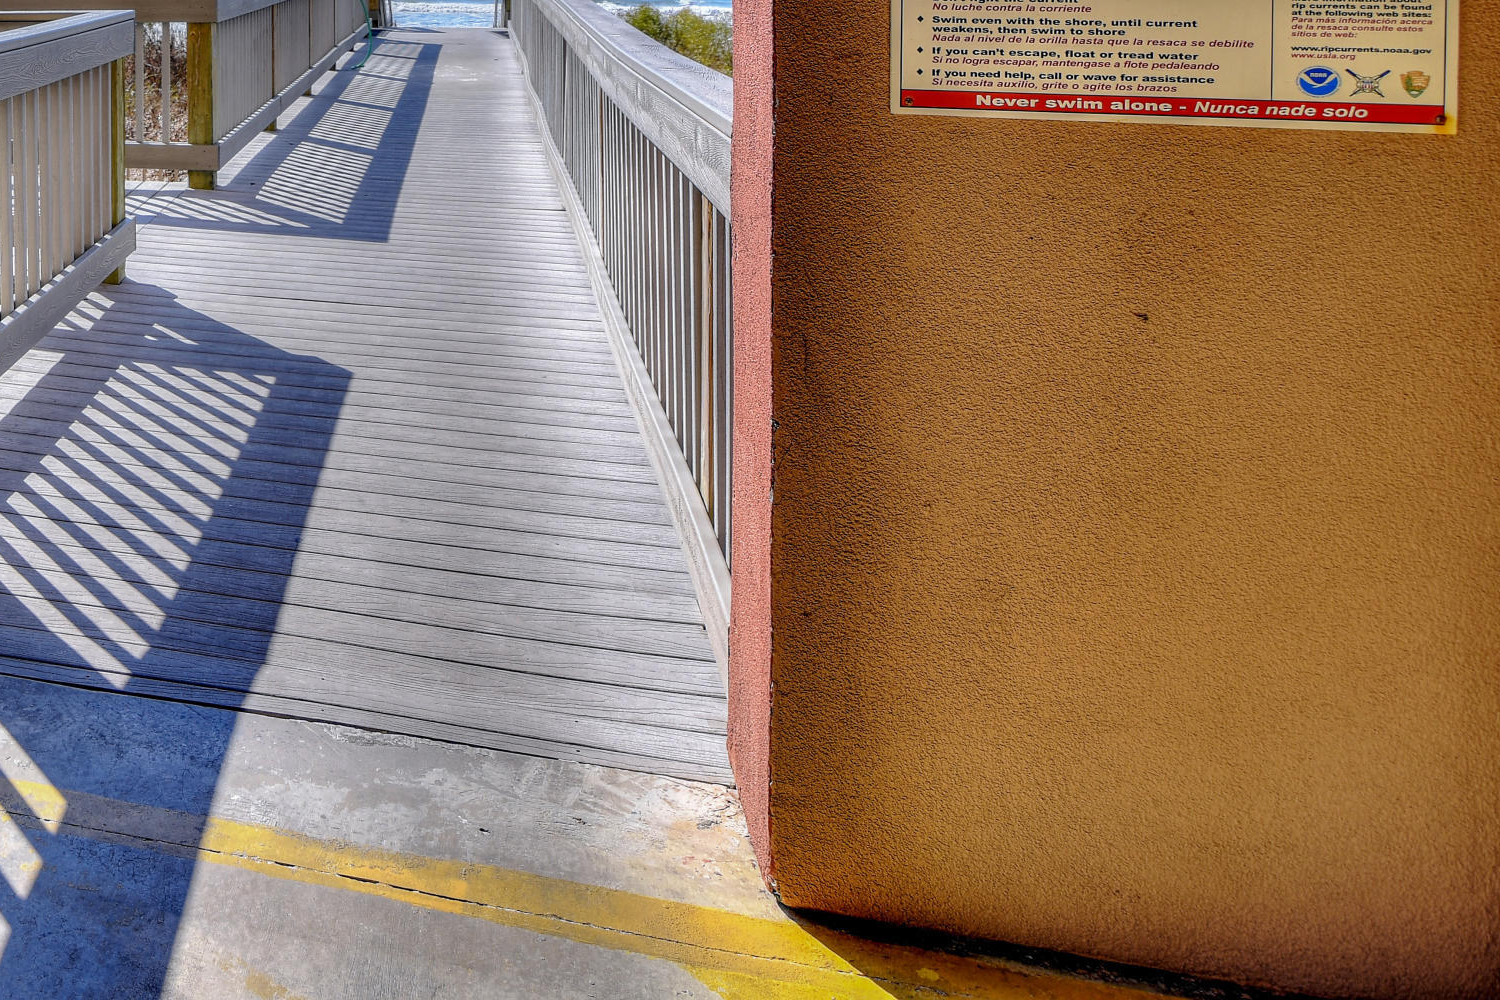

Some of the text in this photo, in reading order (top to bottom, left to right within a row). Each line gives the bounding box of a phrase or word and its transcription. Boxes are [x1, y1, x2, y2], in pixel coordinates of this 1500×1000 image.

[932, 3, 948, 11] No
[1039, 5, 1092, 13] corriente
[1325, 10, 1373, 18] following
[932, 16, 967, 24] Swim
[1006, 17, 1035, 25] with
[1065, 19, 1107, 27] shore,
[1146, 20, 1198, 28] current
[932, 26, 993, 34] weakens,
[1031, 27, 1065, 35] swim
[1088, 28, 1126, 36] shore
[1072, 37, 1104, 45] hasta
[1209, 40, 1254, 48] debilite
[972, 48, 1004, 56] can't
[1009, 50, 1060, 58] escape,
[1291, 46, 1432, 54] www.ripcurrents.noaa.gov
[963, 57, 990, 66] logra
[993, 59, 1038, 67] escapar,
[1124, 61, 1149, 69] flote
[1151, 62, 1220, 70] pedaleando
[1005, 71, 1035, 80] help,
[1039, 72, 1062, 80] call
[1121, 74, 1138, 82] for
[1142, 75, 1215, 84] assistance
[947, 79, 993, 87] necesita
[997, 80, 1038, 89] auxilio,
[1042, 82, 1069, 90] grite
[1083, 83, 1111, 92] agite
[1137, 84, 1177, 93] brazos
[976, 94, 1039, 108] Never
[1045, 98, 1103, 109] swim
[1110, 99, 1173, 112] alone
[1194, 102, 1259, 115] Nunca
[1265, 104, 1317, 116] nade
[1322, 106, 1369, 118] solo
